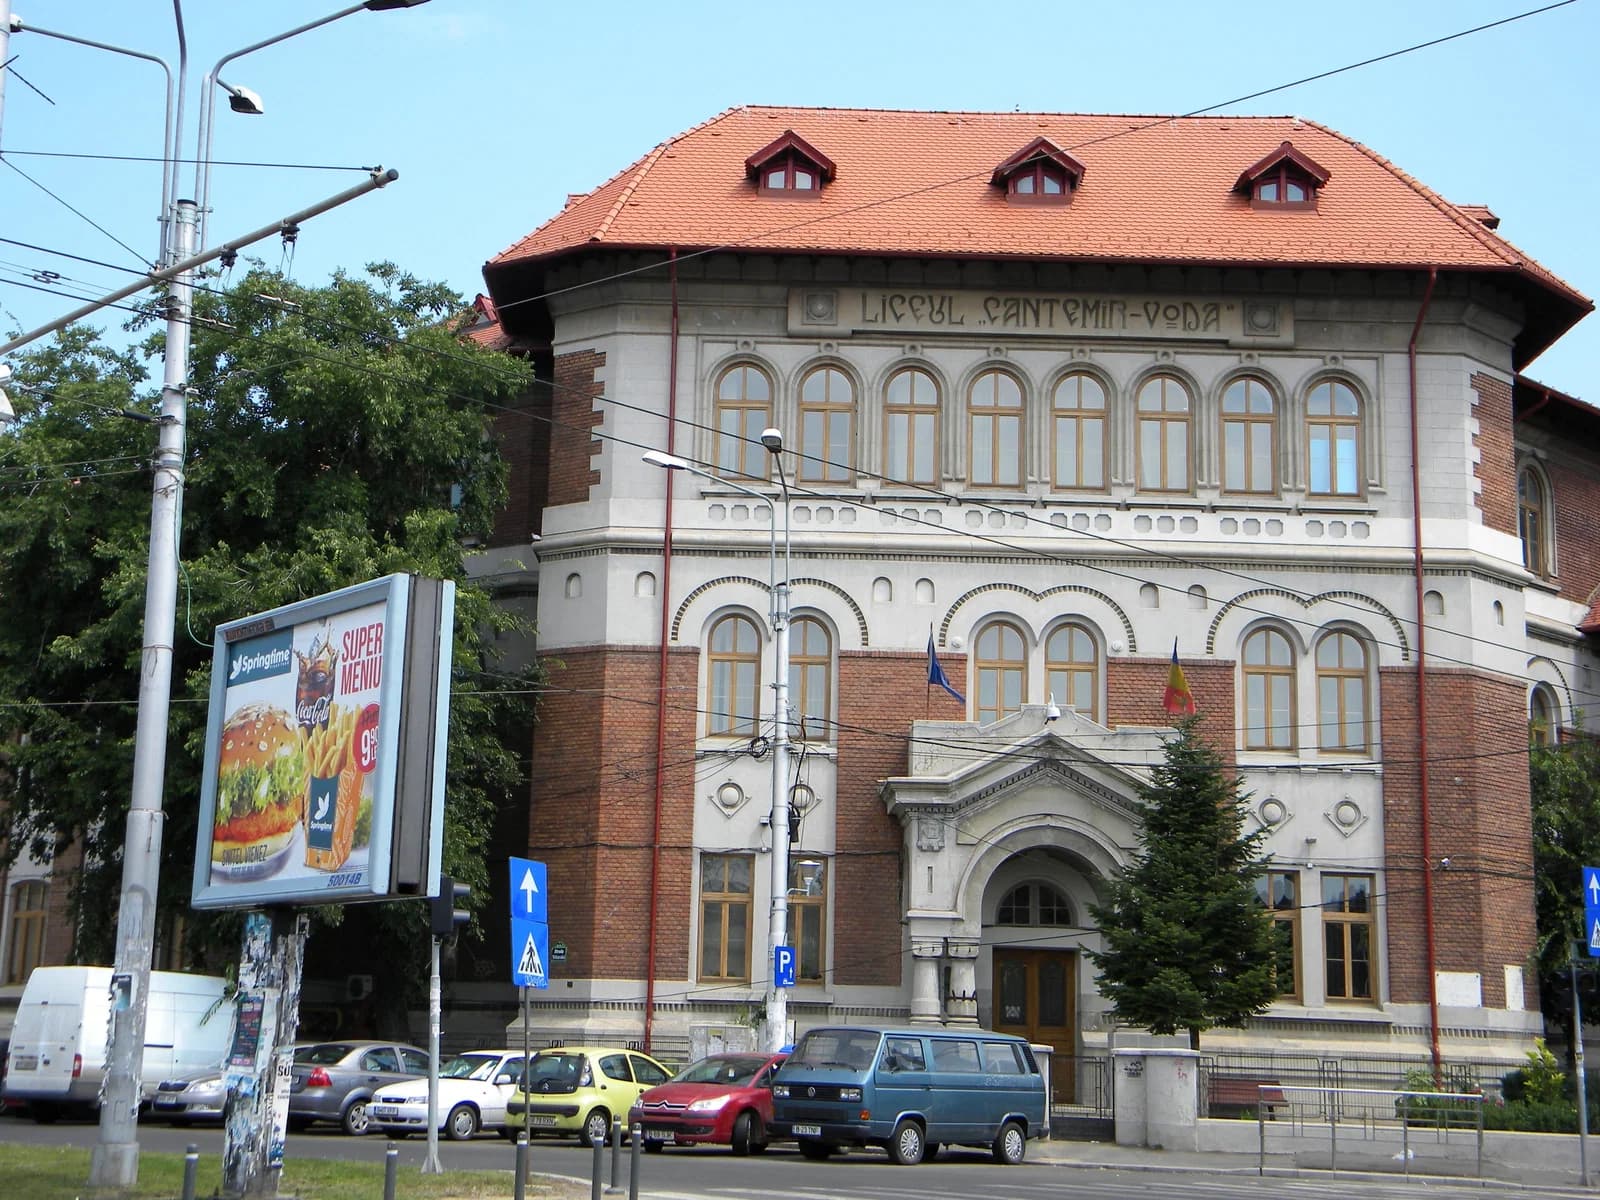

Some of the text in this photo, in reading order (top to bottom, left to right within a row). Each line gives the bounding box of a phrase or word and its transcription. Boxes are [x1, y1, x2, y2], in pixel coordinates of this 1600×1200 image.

[341, 622, 384, 663] SUPER
[242, 648, 290, 674] Springtime
[340, 656, 383, 696] MENIU
[328, 872, 362, 887] 50014B
[780, 950, 791, 974] P
